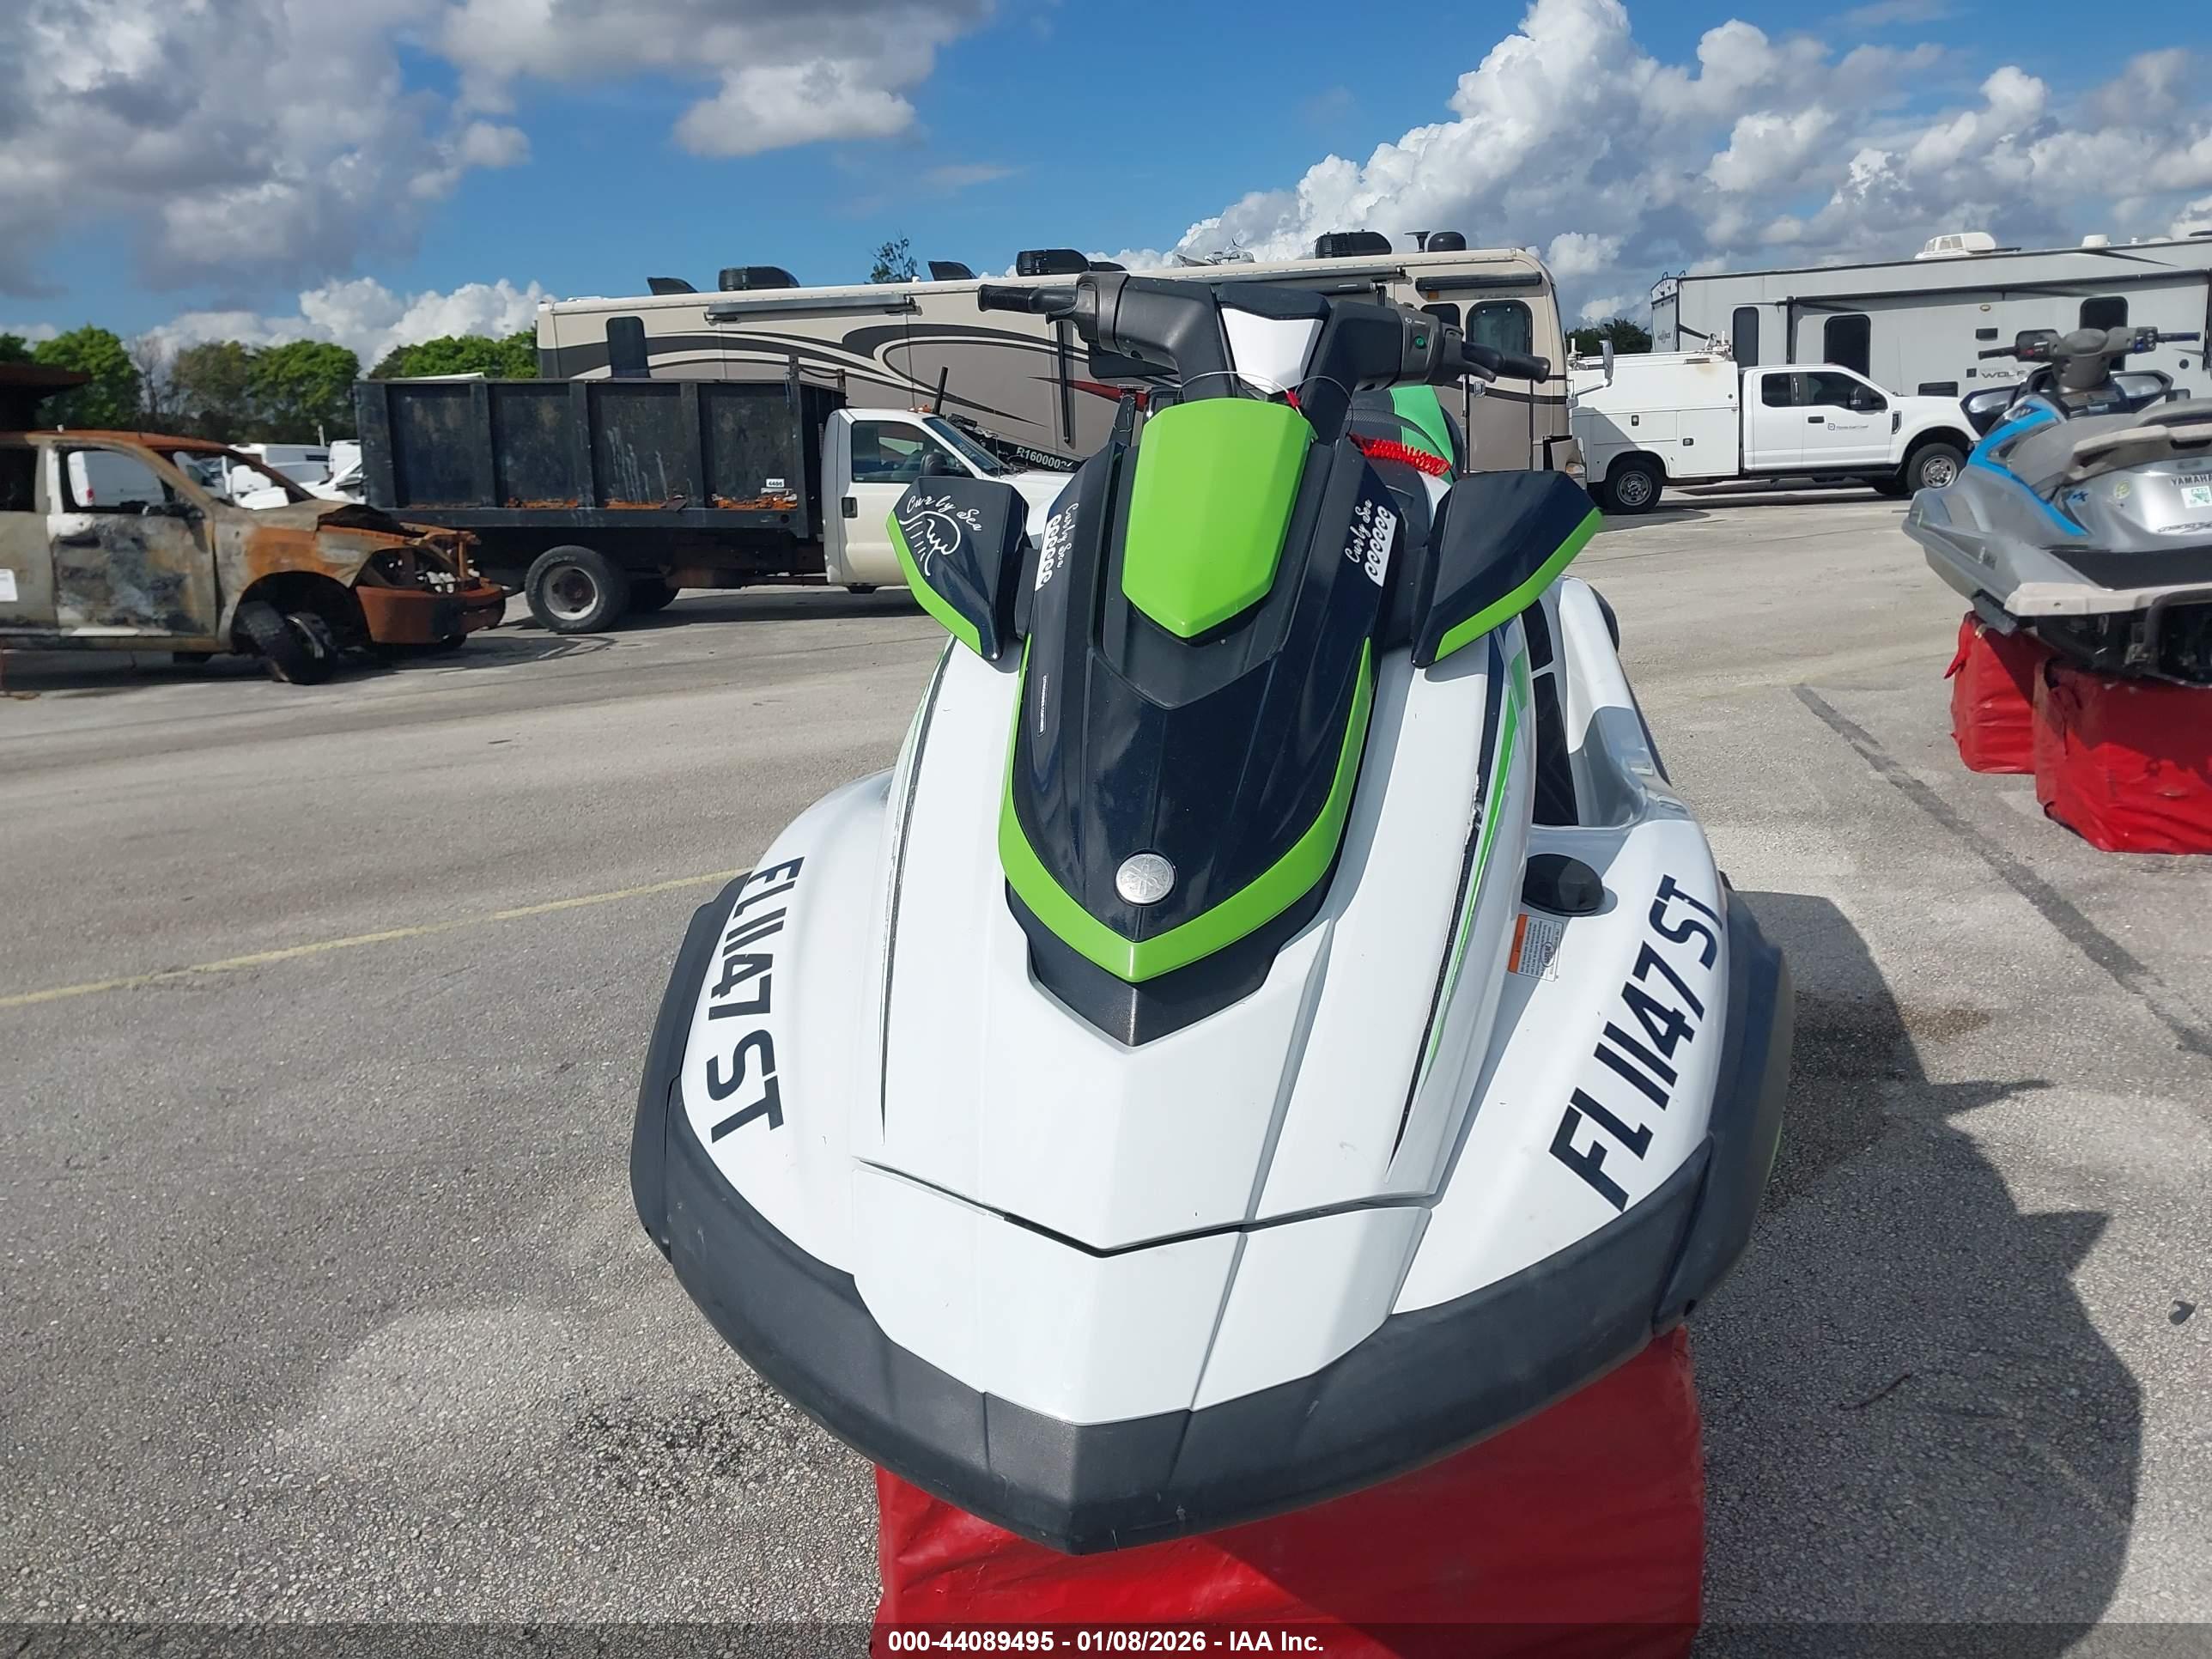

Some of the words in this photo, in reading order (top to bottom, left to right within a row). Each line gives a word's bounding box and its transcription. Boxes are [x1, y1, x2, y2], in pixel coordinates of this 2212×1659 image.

[1981, 370, 2026, 379] WOLF
[907, 495, 956, 514] Curly
[957, 508, 982, 531] Sea
[732, 856, 805, 921] FL
[1648, 873, 1723, 971] ST
[708, 906, 787, 1021] 1147
[1593, 939, 1705, 1111] 1147
[706, 1029, 784, 1144] ST
[1548, 1086, 1654, 1212] FL
